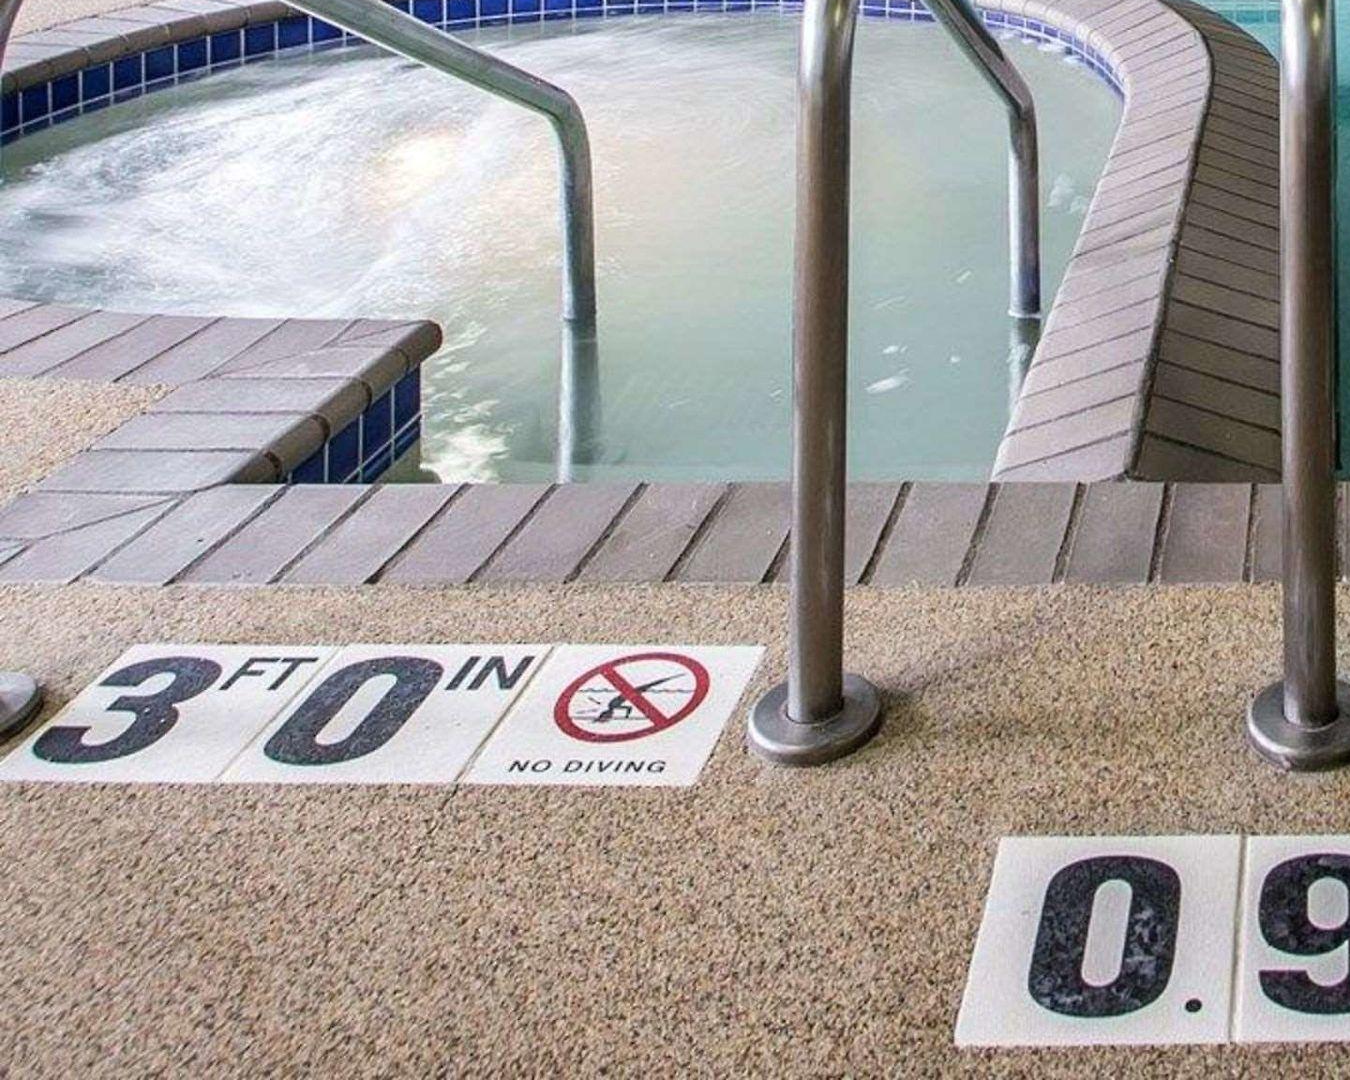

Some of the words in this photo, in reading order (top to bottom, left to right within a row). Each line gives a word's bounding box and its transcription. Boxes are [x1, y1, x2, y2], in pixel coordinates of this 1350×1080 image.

[219, 656, 319, 691] FT
[444, 655, 535, 691] IN
[32, 655, 223, 764] 3
[263, 655, 445, 766] 0
[507, 759, 553, 774] NO
[562, 759, 667, 774] DIVING
